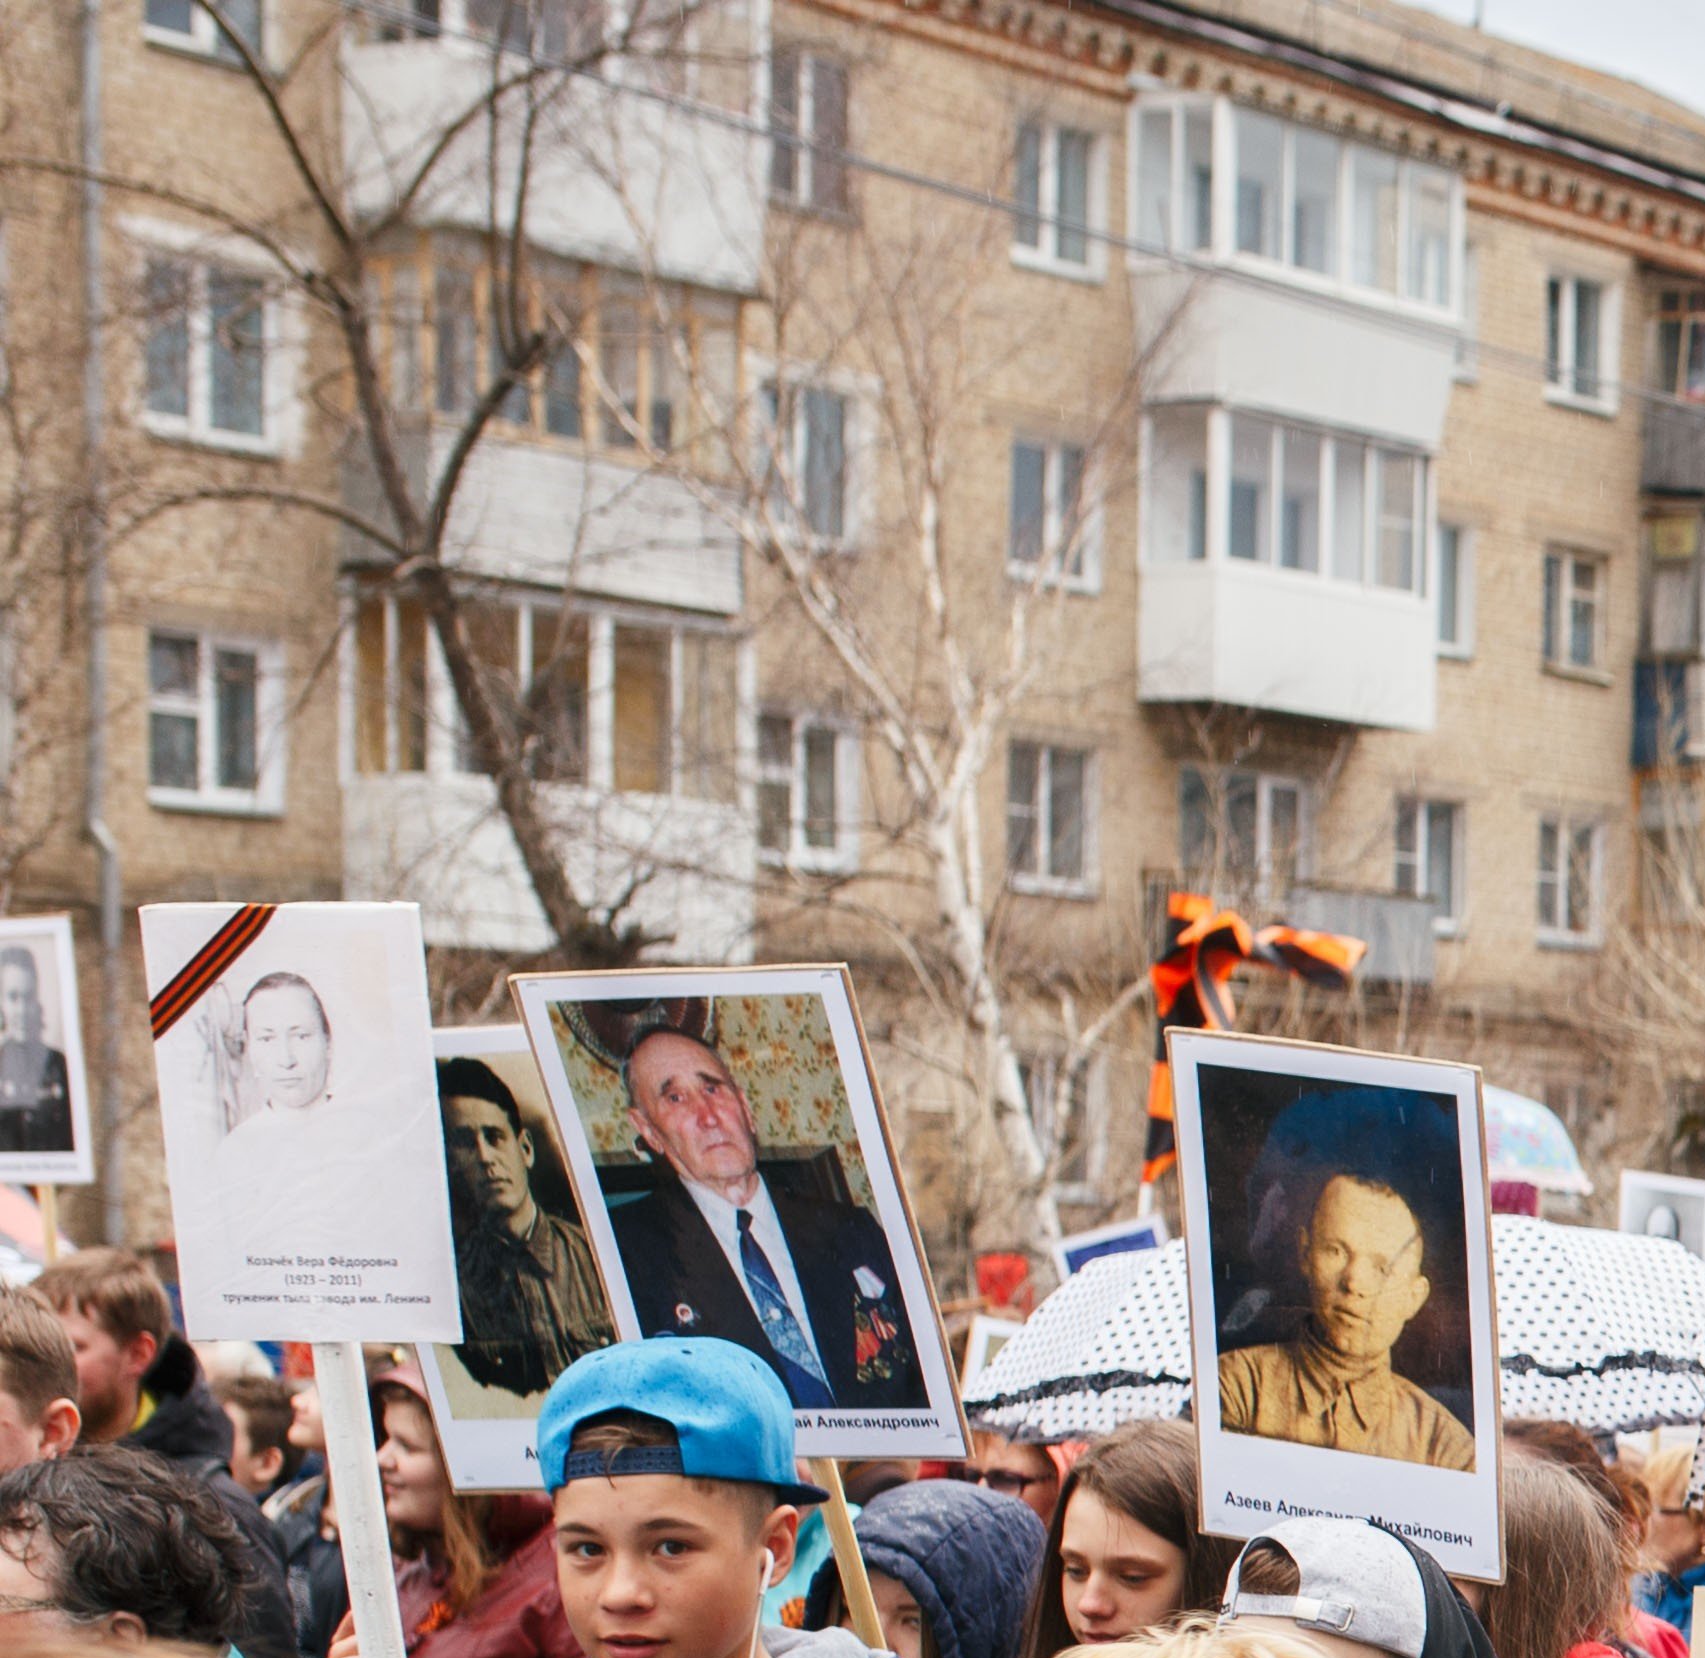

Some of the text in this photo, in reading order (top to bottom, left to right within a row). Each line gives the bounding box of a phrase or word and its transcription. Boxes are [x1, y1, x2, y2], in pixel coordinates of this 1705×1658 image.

[296, 1256, 325, 1268] Вера
[328, 1256, 398, 1268] Фёдоровна
[284, 1273, 315, 1287] (1923
[329, 1273, 362, 1287] 2011)
[222, 1293, 280, 1305] труженик
[360, 1294, 381, 1304] им.
[384, 1292, 431, 1304] Ленина
[795, 1414, 940, 1432] ай Александрович
[1224, 1490, 1272, 1513] Азеев
[1368, 1514, 1473, 1548] Михайлович
